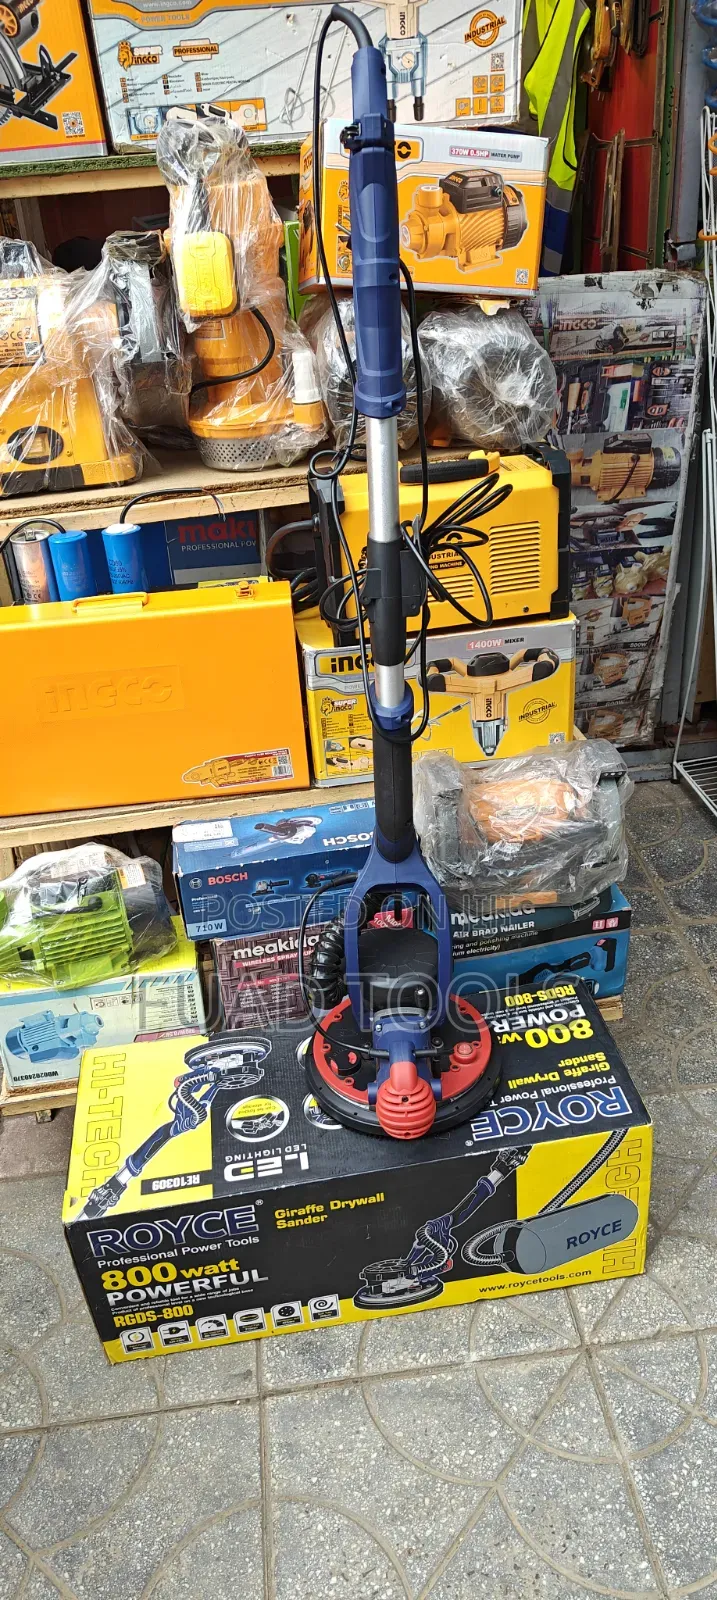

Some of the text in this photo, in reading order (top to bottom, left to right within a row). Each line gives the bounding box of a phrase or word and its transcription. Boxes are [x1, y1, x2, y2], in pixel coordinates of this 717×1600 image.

[464, 16, 506, 41] INDUSTRIAL
[174, 45, 218, 54] PROFESSIONAL
[451, 148, 469, 157] 370W
[181, 541, 239, 552] PROFESSIONAL
[469, 639, 502, 649] 1400W
[518, 702, 556, 720] INDUSTRIAL
[207, 872, 248, 886] BOSCH
[472, 927, 498, 937] BRAD
[501, 921, 535, 931] NAILER
[479, 936, 510, 947] polishing
[511, 932, 539, 940] machine
[242, 957, 275, 967] WIRELESS
[276, 952, 298, 960] SPRAY
[505, 984, 576, 1008] RGDS-800
[493, 1003, 586, 1034] POWER
[525, 1018, 594, 1049] 800
[558, 1052, 606, 1068] Sander
[508, 1061, 610, 1090] Giraffe Drywall
[541, 1075, 617, 1096] Professional
[500, 1091, 538, 1103] Power
[470, 1086, 633, 1142] ROYCE
[225, 1144, 307, 1162] LED LIGHTING
[223, 1152, 309, 1182] LED
[152, 1173, 200, 1192] RE10309
[275, 1192, 385, 1219] Giraffe Drywall
[86, 1204, 259, 1258] ROYCE
[276, 1214, 328, 1229] Sander
[566, 1219, 622, 1250] ROYCE
[98, 1236, 259, 1268] Professional Power Tools
[102, 1258, 240, 1290] 800 watt
[479, 1269, 591, 1293] www.roycetools.com
[106, 1269, 268, 1306] POWERFUL
[140, 1303, 170, 1311] professional
[207, 1290, 240, 1300] technological
[113, 1304, 194, 1328] RGDS-800
